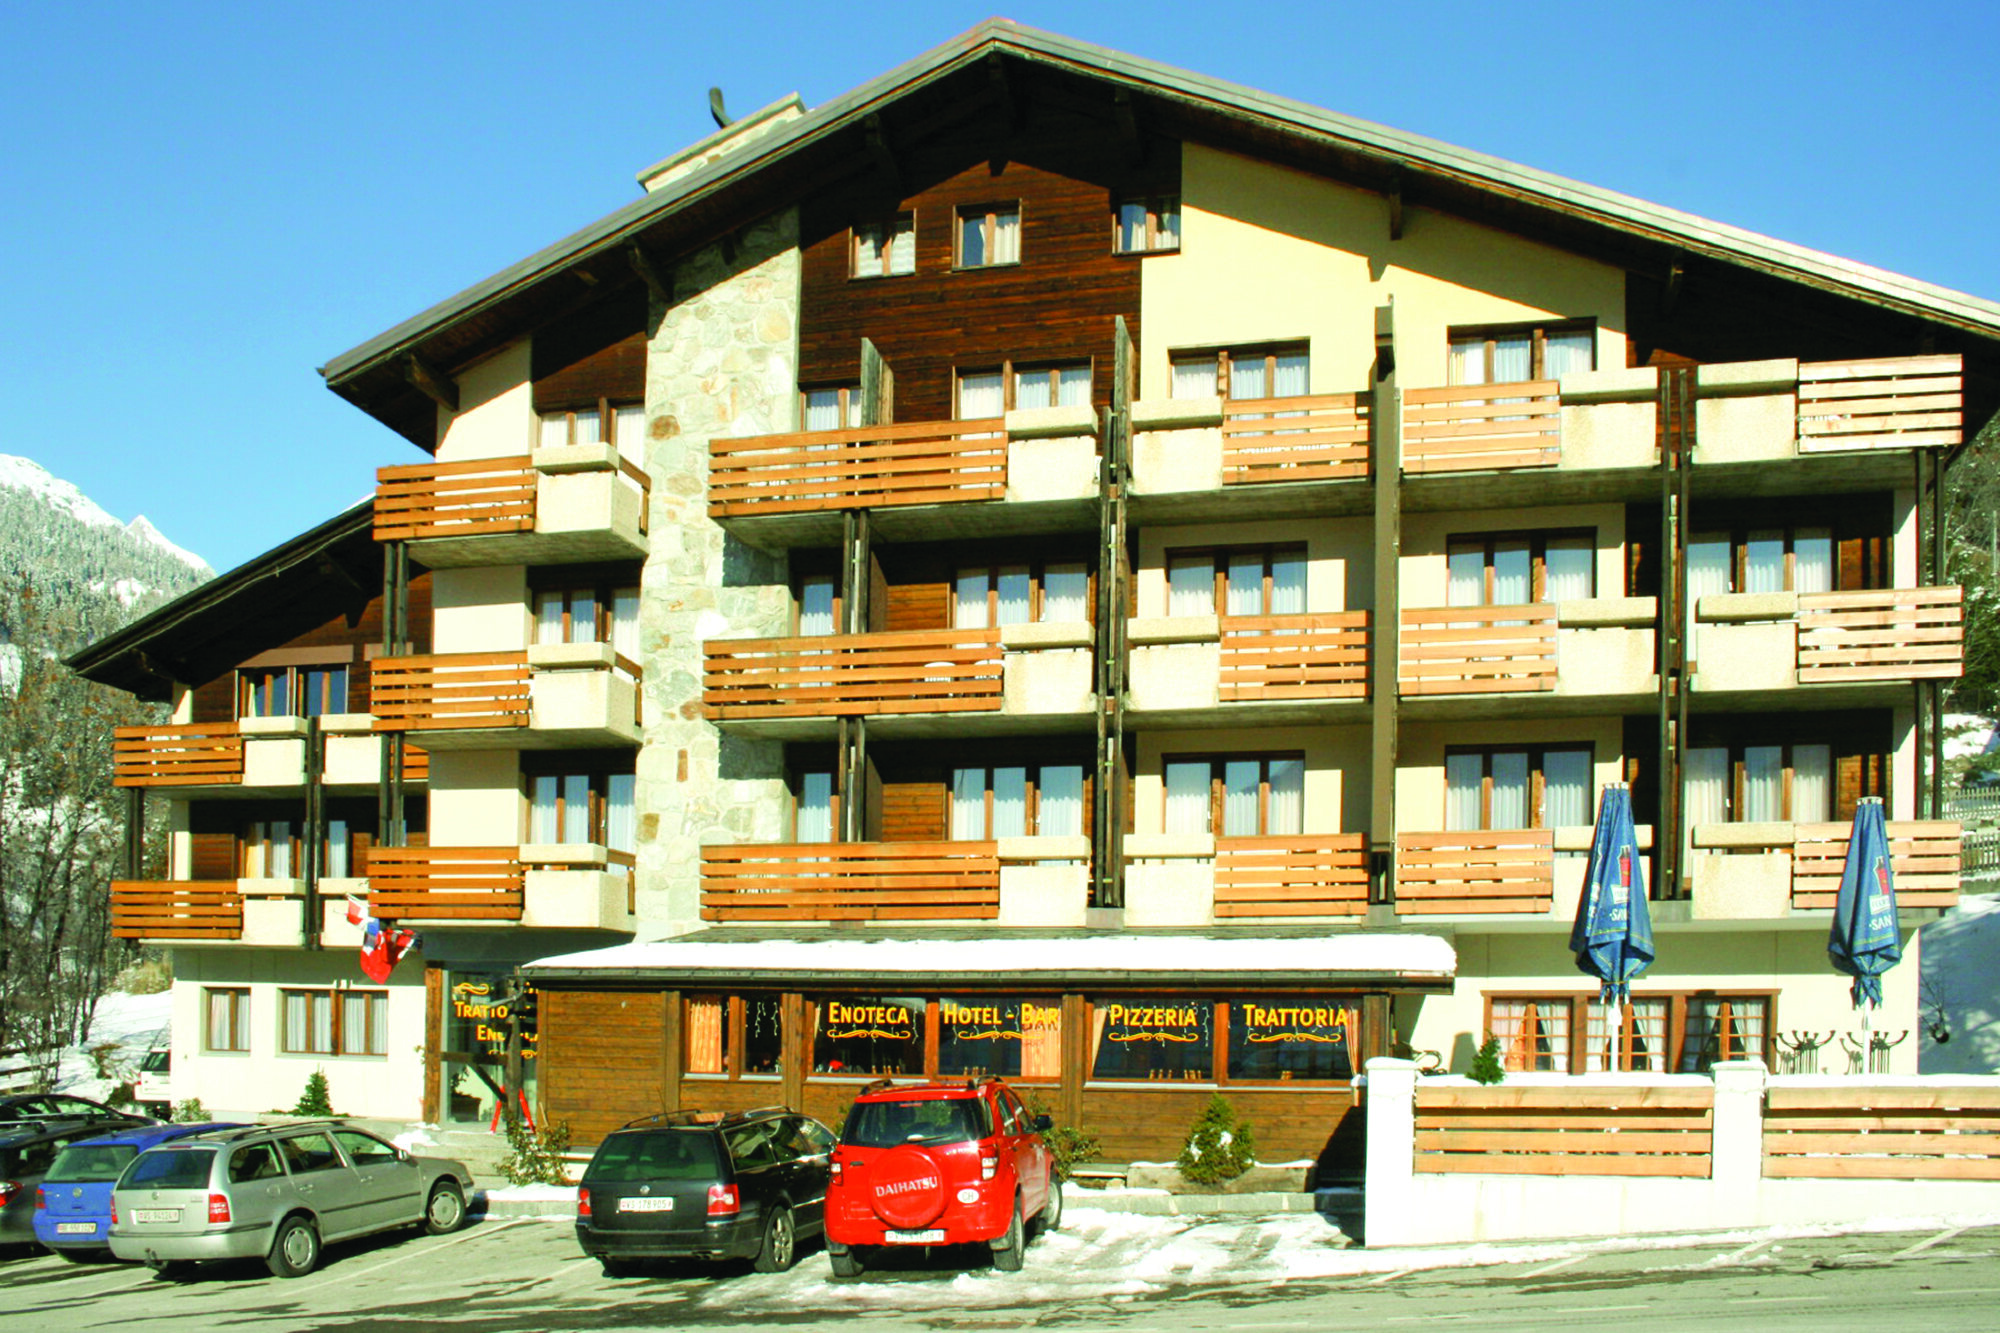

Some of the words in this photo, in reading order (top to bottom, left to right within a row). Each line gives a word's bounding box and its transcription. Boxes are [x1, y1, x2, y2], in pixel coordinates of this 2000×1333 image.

[828, 1001, 910, 1025] ENOTECA
[943, 1002, 1002, 1025] HOTEL
[1021, 1002, 1060, 1026] BAR
[1109, 1004, 1198, 1026] PIZZERIA
[1242, 1004, 1348, 1028] TRATTORIA
[875, 1176, 939, 1198] DAIHATSU
